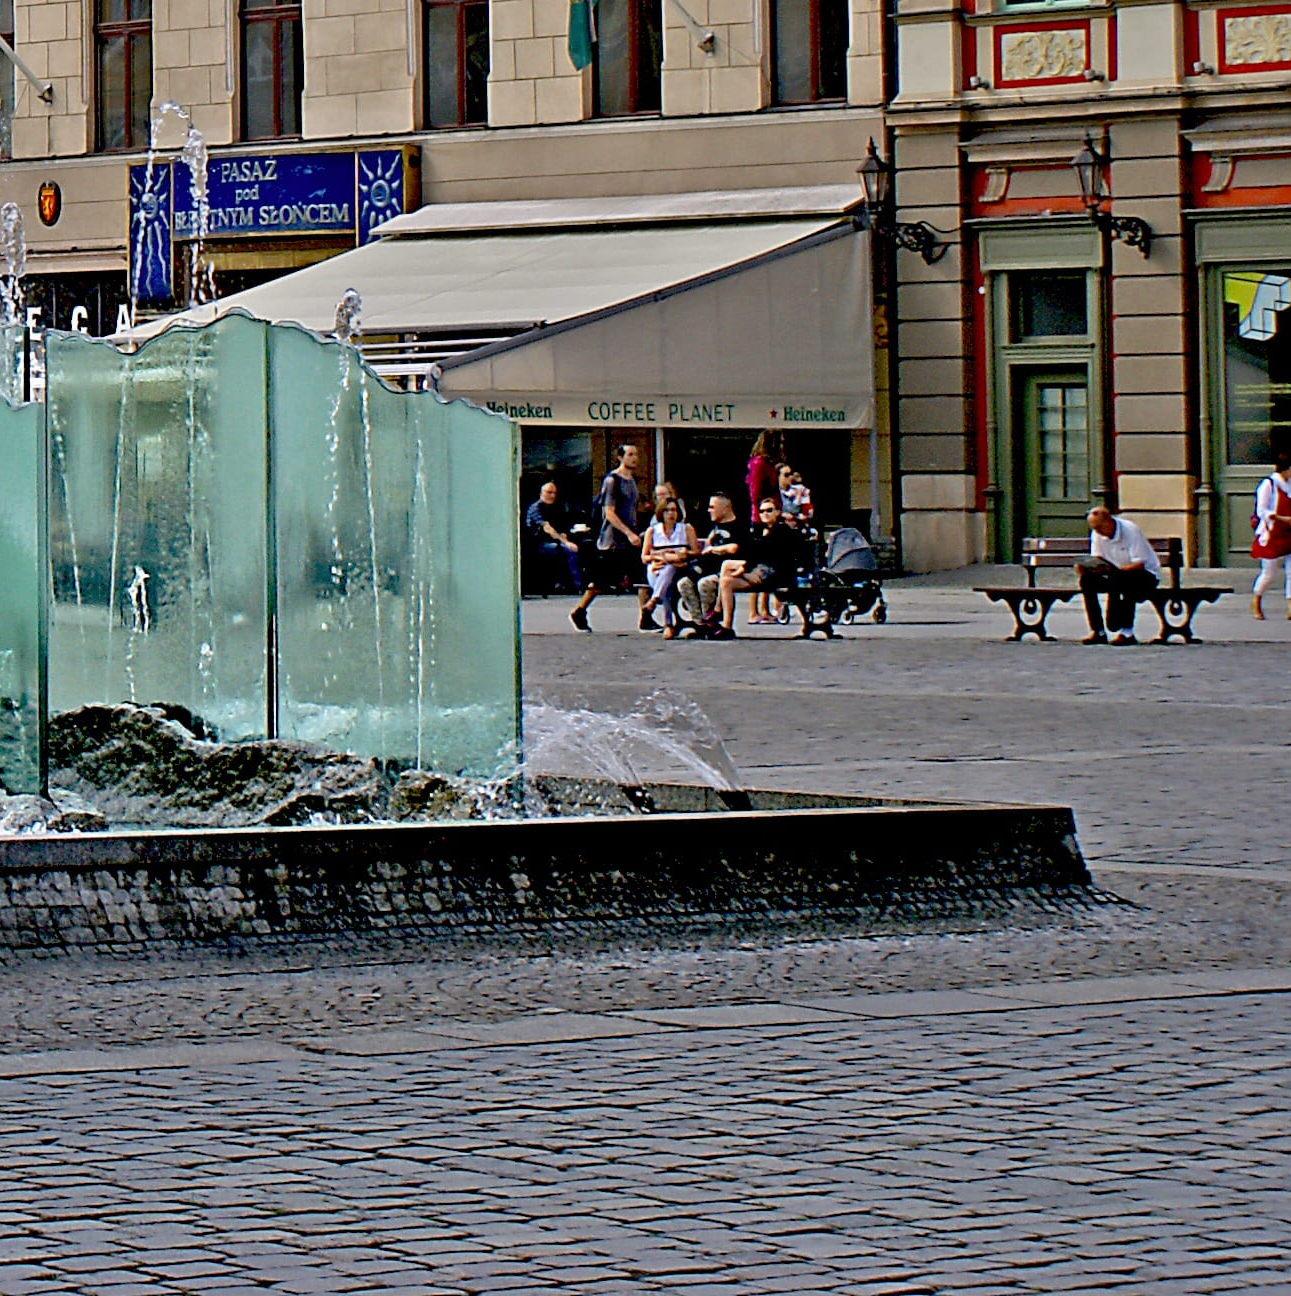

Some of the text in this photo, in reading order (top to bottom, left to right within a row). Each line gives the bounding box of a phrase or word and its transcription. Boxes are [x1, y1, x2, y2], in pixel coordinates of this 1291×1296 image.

[220, 159, 278, 183] PASAŻ
[235, 184, 259, 204] pod
[259, 202, 350, 225] SŁOŃCEM
[486, 401, 553, 418] Heineken
[587, 402, 735, 422] COFFEE PLANET
[783, 407, 845, 422] Heineken
